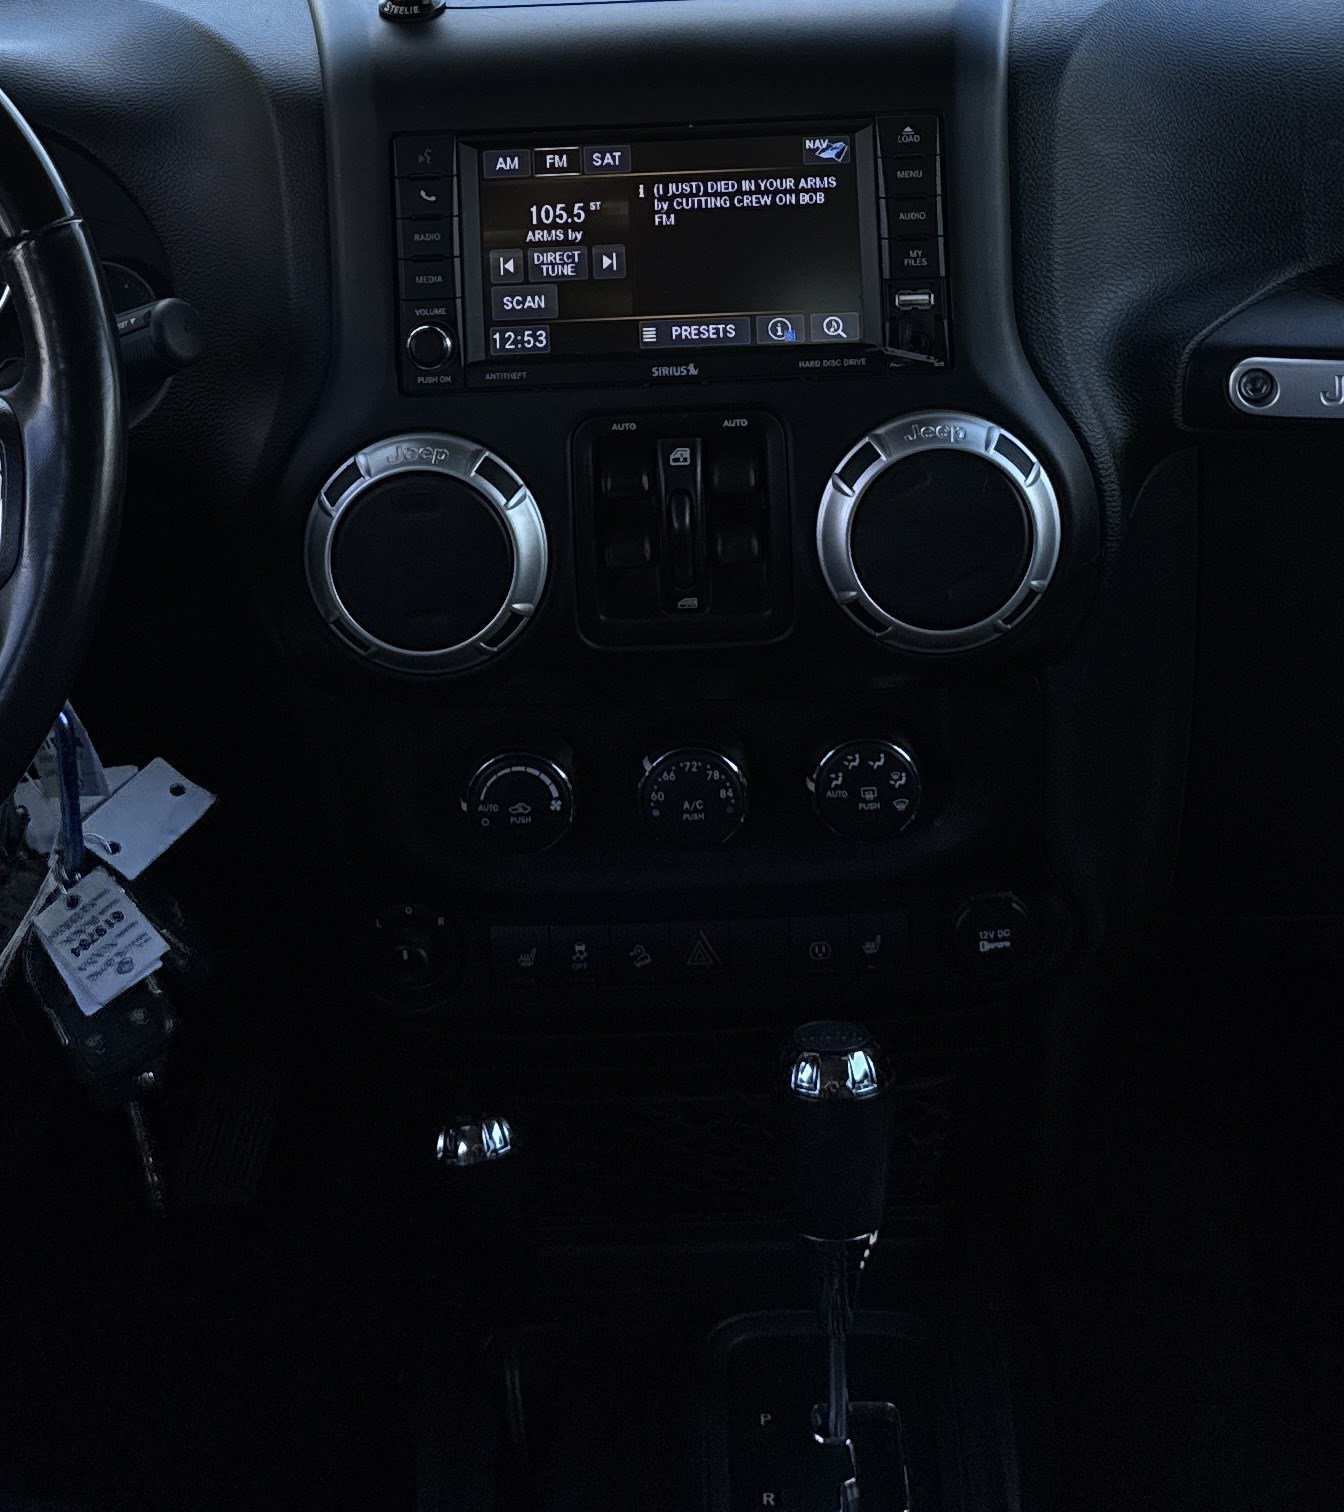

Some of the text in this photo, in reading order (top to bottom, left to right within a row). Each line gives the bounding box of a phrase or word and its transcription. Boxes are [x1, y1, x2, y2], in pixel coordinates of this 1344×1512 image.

[805, 139, 828, 150] NAV
[897, 134, 921, 144] LOAD
[496, 156, 519, 170] AM
[546, 155, 568, 168] FM
[592, 152, 622, 166] SAT
[896, 169, 923, 180] MENU
[667, 181, 705, 196] JUST)
[708, 180, 738, 193] DIED
[741, 179, 756, 192] IN
[758, 178, 794, 191] YOUR
[798, 176, 837, 189] ARMS
[654, 192, 825, 213] by CUTTING CREW ON BOB
[530, 201, 602, 225] 105.5 ST
[654, 213, 675, 226] FM
[898, 211, 927, 221] AUDIO
[413, 232, 442, 242] RADIO
[525, 229, 583, 243] ARMS by
[533, 251, 581, 265] DIRECT
[540, 264, 576, 277] TUNE
[503, 294, 546, 310] SCAN
[671, 324, 736, 339] PRESETS
[492, 330, 547, 349] 12:53
[651, 366, 688, 377] SIRIUS
[612, 422, 637, 431] AUTO
[722, 418, 748, 428] AUTO
[904, 424, 967, 443] Jeep
[386, 445, 450, 465] Jeep
[826, 790, 848, 798] AUTO
[478, 804, 499, 812] AUTO
[682, 800, 704, 811] A/C
[858, 802, 880, 810] PUSH
[510, 815, 531, 825] PUSH
[760, 1413, 772, 1426] P
[762, 1492, 775, 1507] R
